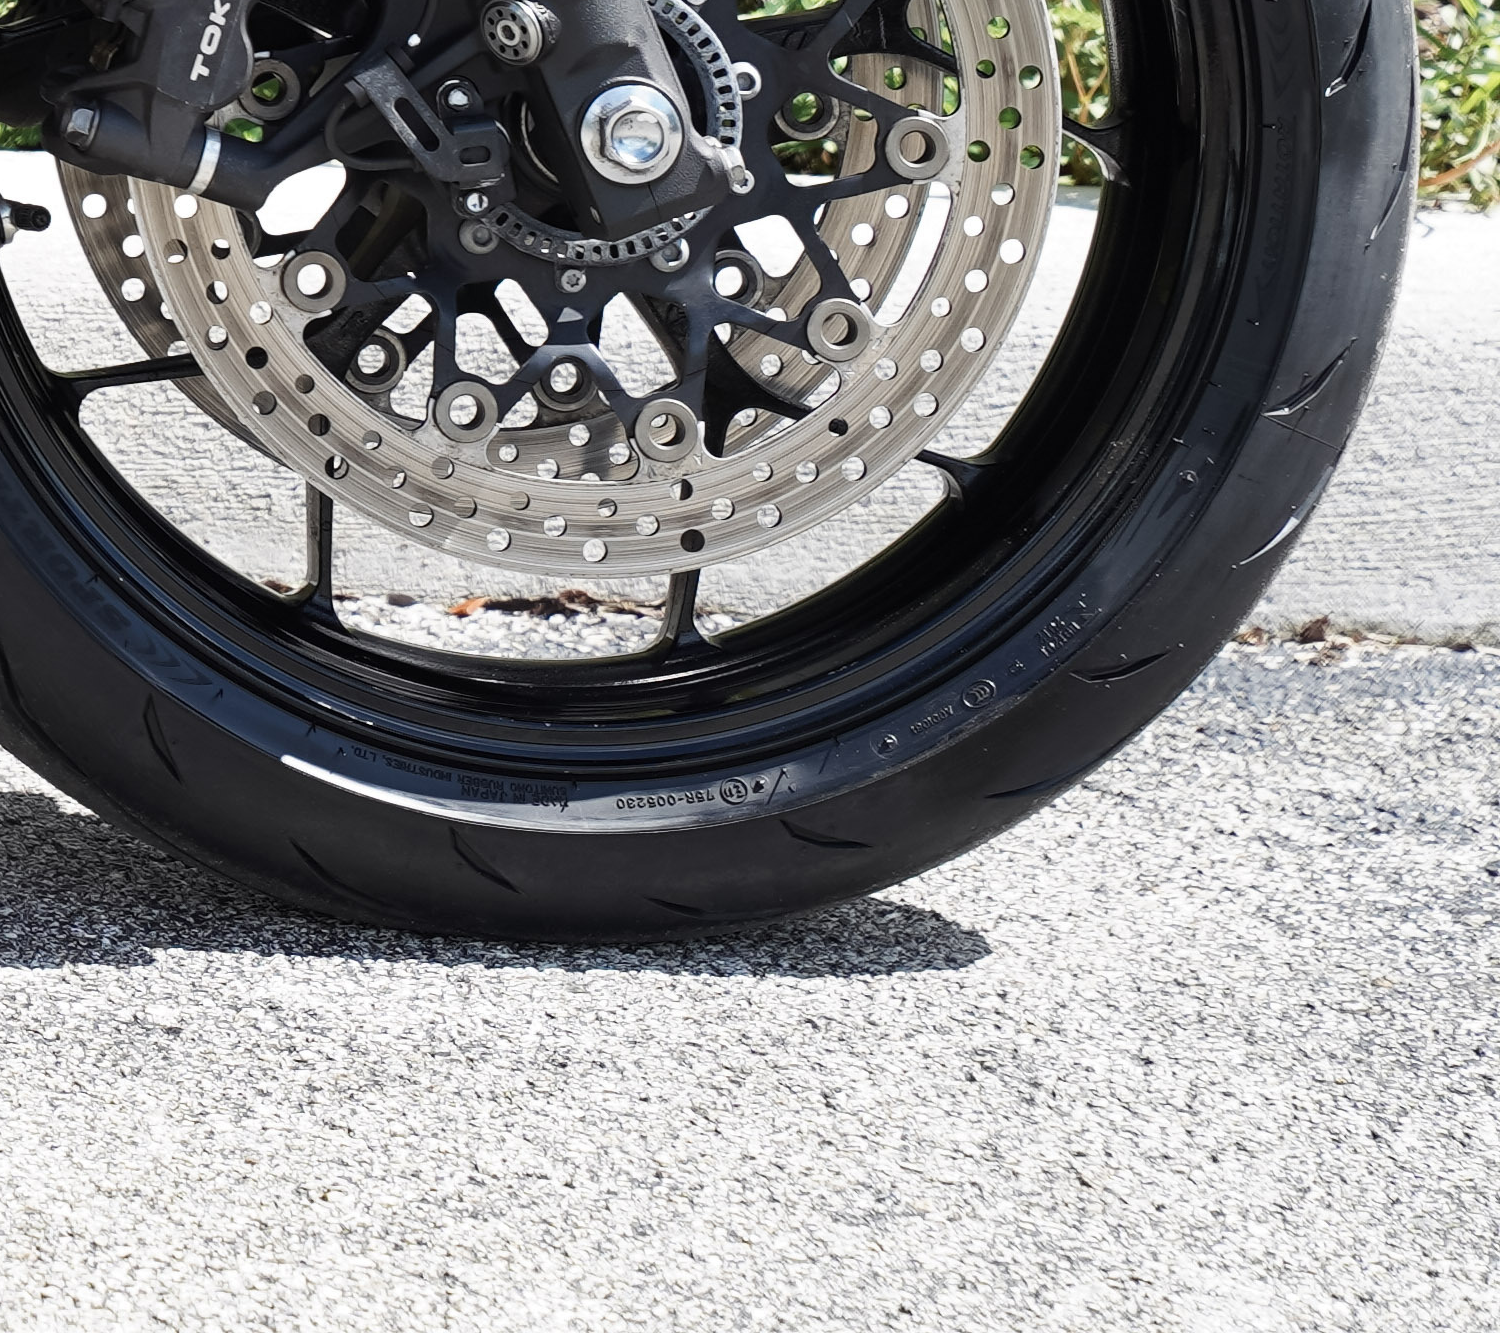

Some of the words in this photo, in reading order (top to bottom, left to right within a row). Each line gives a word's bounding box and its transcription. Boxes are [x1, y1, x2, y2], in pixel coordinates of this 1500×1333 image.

[350, 744, 378, 764] LTD.
[460, 784, 508, 806] JAPAN
[615, 789, 715, 811] 75R-005230
